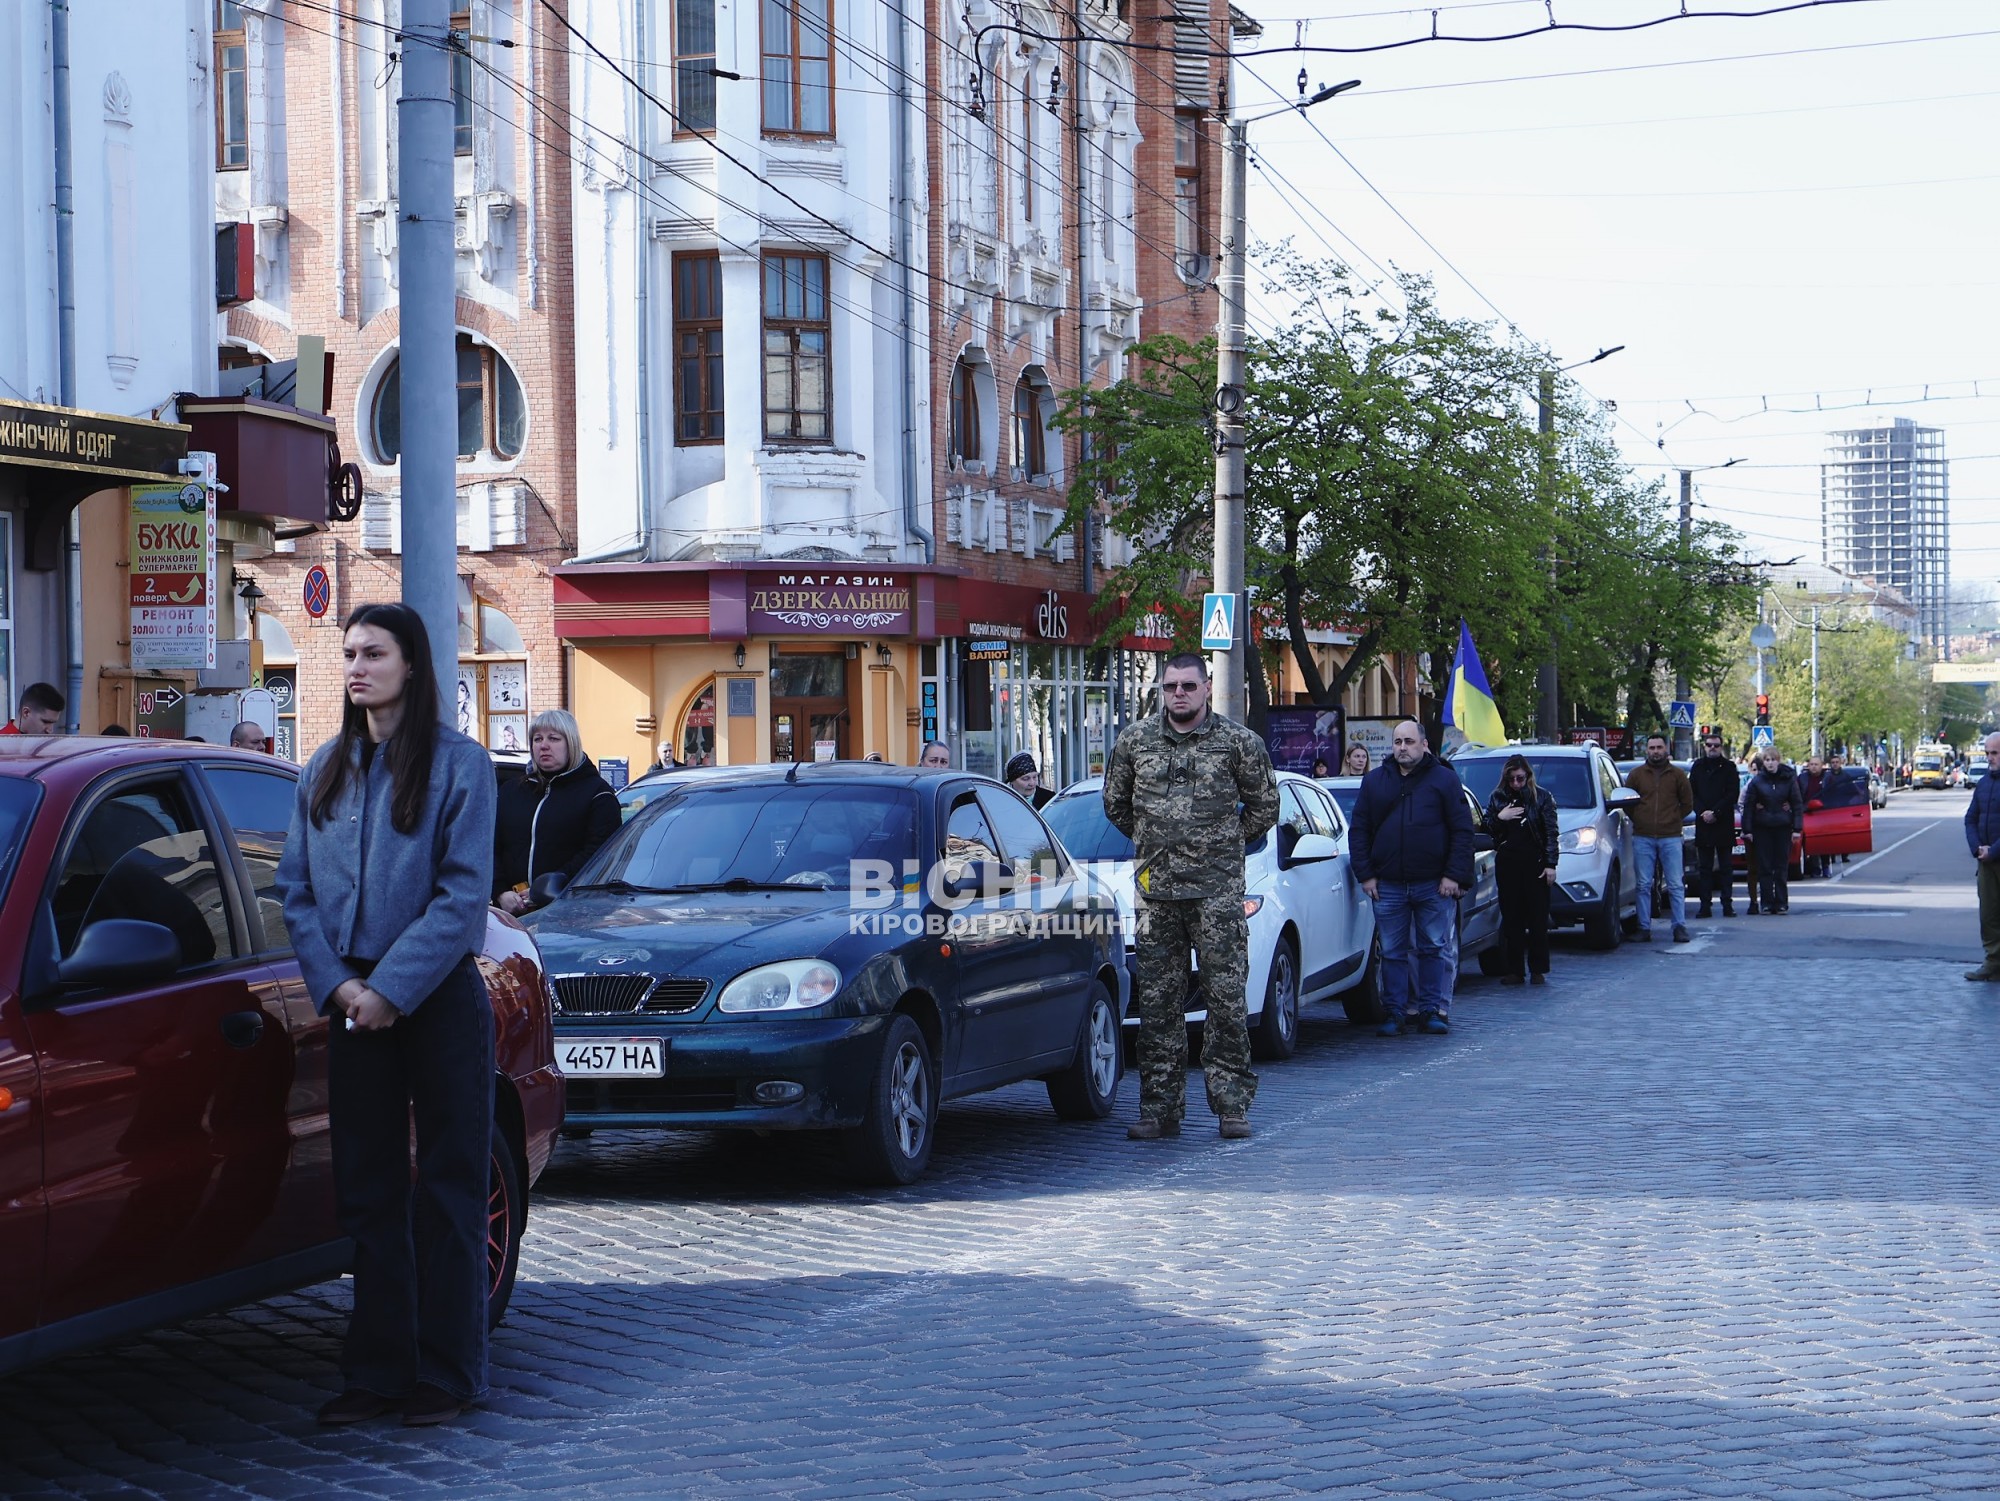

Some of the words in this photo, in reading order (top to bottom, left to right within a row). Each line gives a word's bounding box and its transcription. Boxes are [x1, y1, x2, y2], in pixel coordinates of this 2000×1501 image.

[0, 420, 70, 453] ЖІНОЧИЙ
[76, 430, 116, 462] ОДЯГ
[138, 553, 198, 563] КНИЖКОВИЙ
[138, 564, 198, 572] СУПЕРМАРКЕТ
[145, 577, 155, 593] 2
[779, 575, 893, 586] МАГАЗИН
[133, 595, 168, 604] поверх
[750, 588, 910, 612] ДЗЕРКАЛЬНИЙ
[142, 609, 195, 620] РЕМОНТ
[1038, 589, 1067, 639] elis
[970, 641, 1008, 652] ОБМІН
[969, 651, 1009, 660] ВАЛЮТ
[924, 683, 937, 741] ОБМІН
[565, 1046, 616, 1070] 4457
